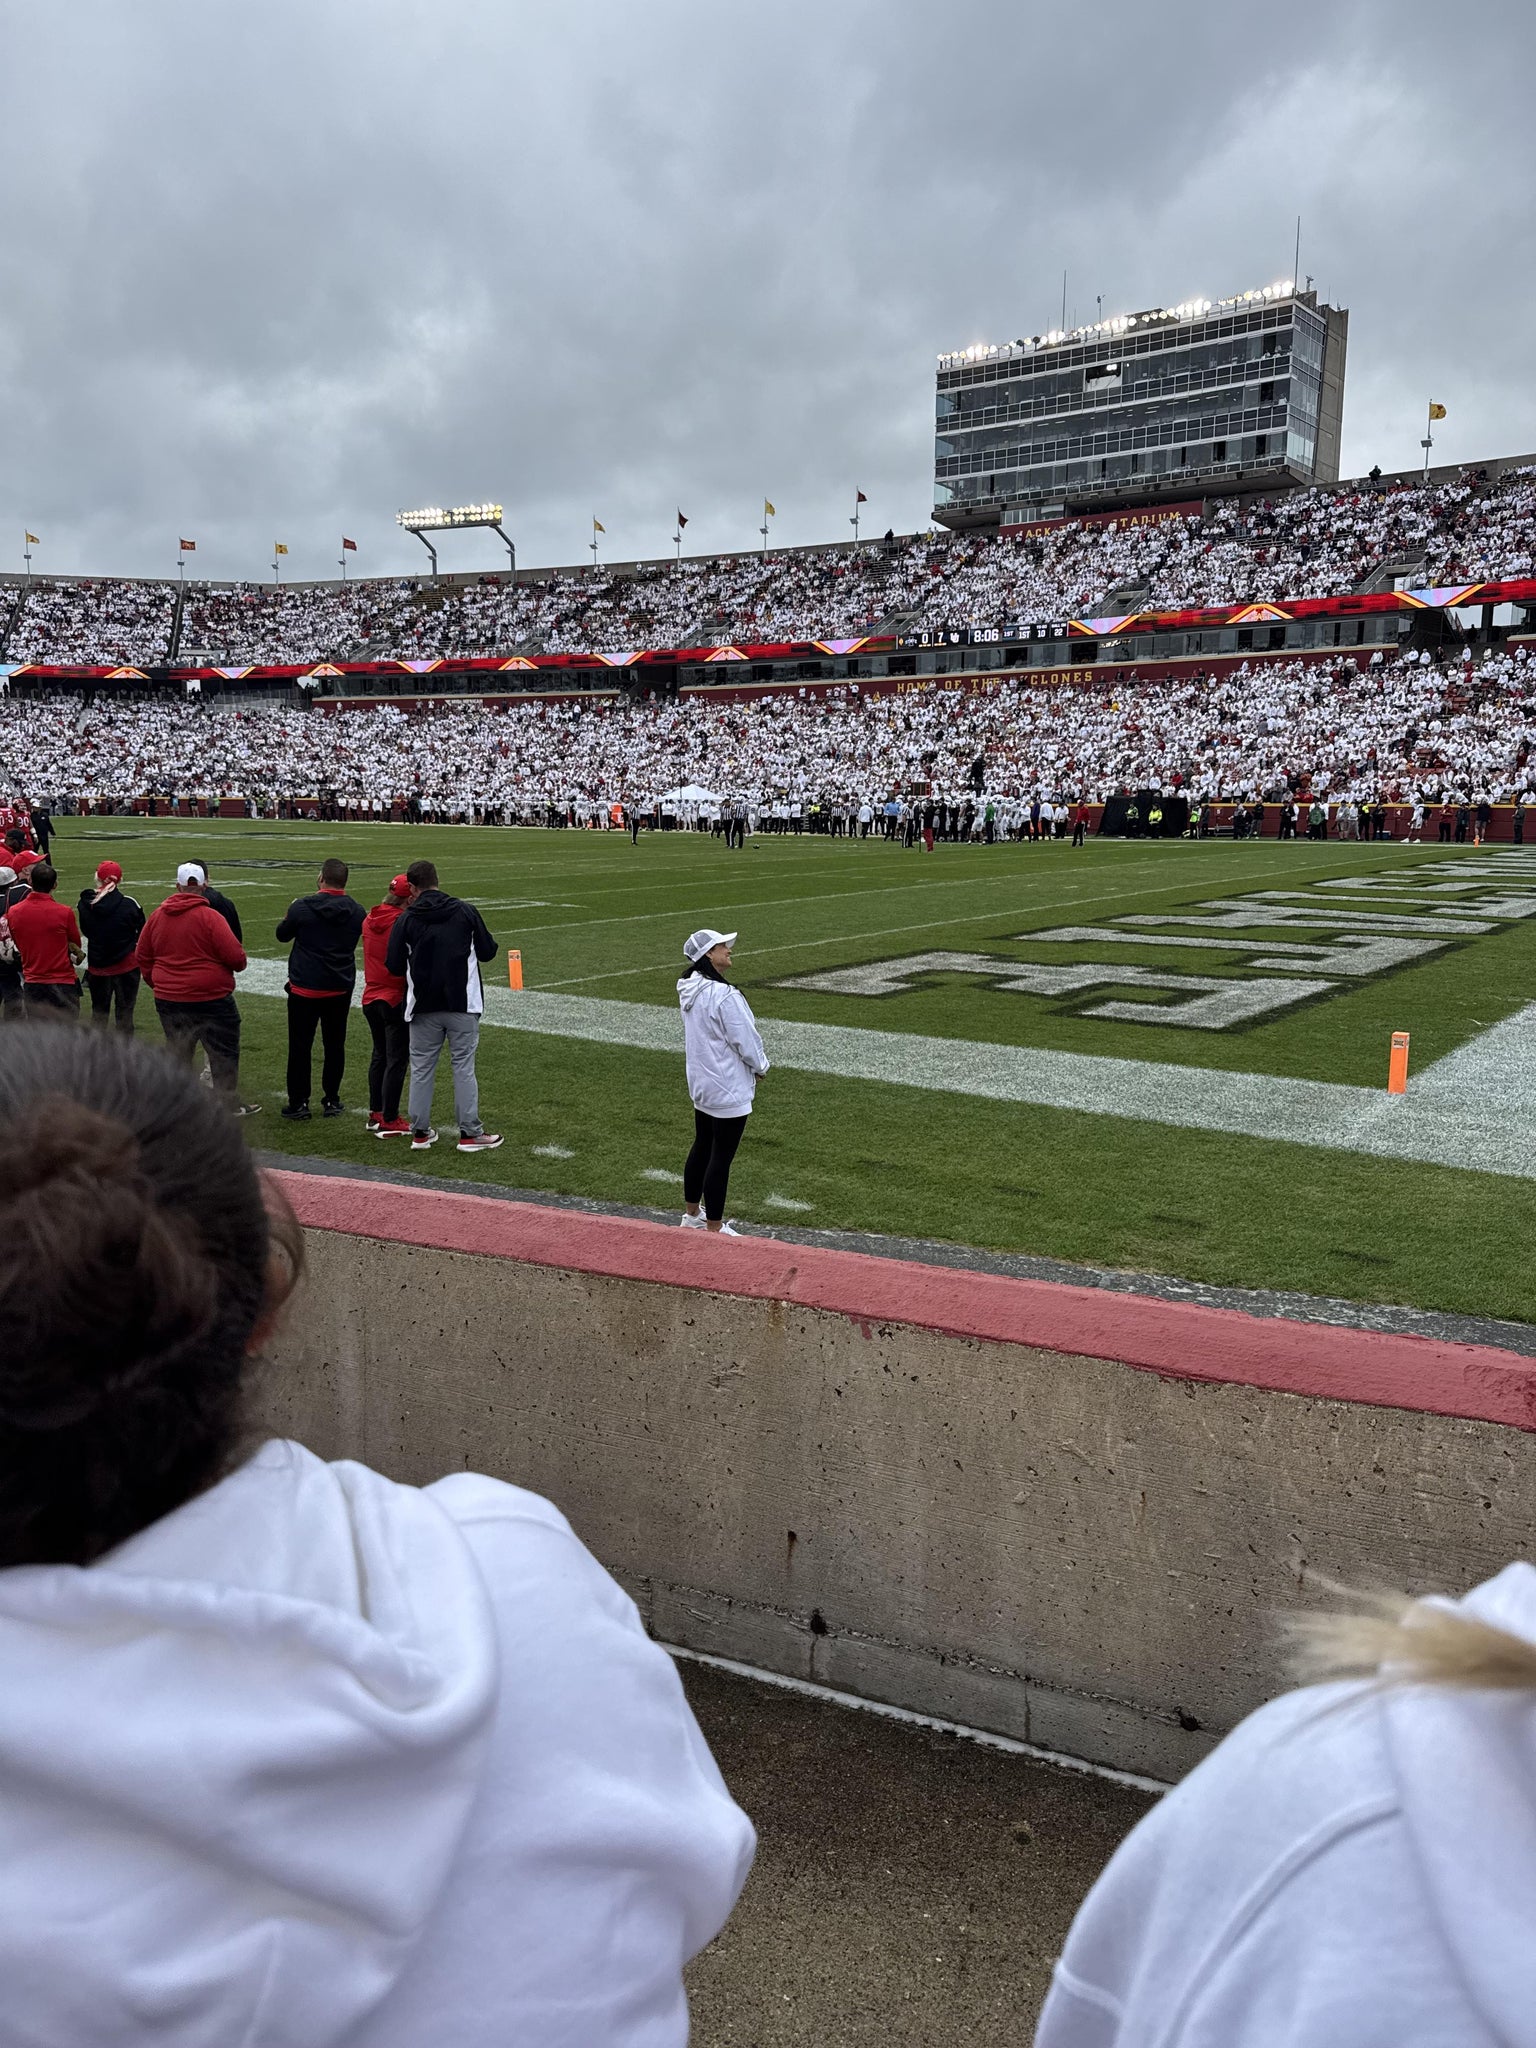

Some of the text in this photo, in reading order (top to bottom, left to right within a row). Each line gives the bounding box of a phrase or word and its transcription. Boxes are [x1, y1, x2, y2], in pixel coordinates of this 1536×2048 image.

[1025, 526, 1050, 538] ACK
[937, 631, 944, 643] 7
[974, 629, 999, 642] 8:06
[1018, 630, 1031, 639] 1ST
[1037, 630, 1046, 638] 10
[1054, 628, 1063, 637] 22
[922, 633, 928, 644] 0
[944, 680, 961, 690] OF
